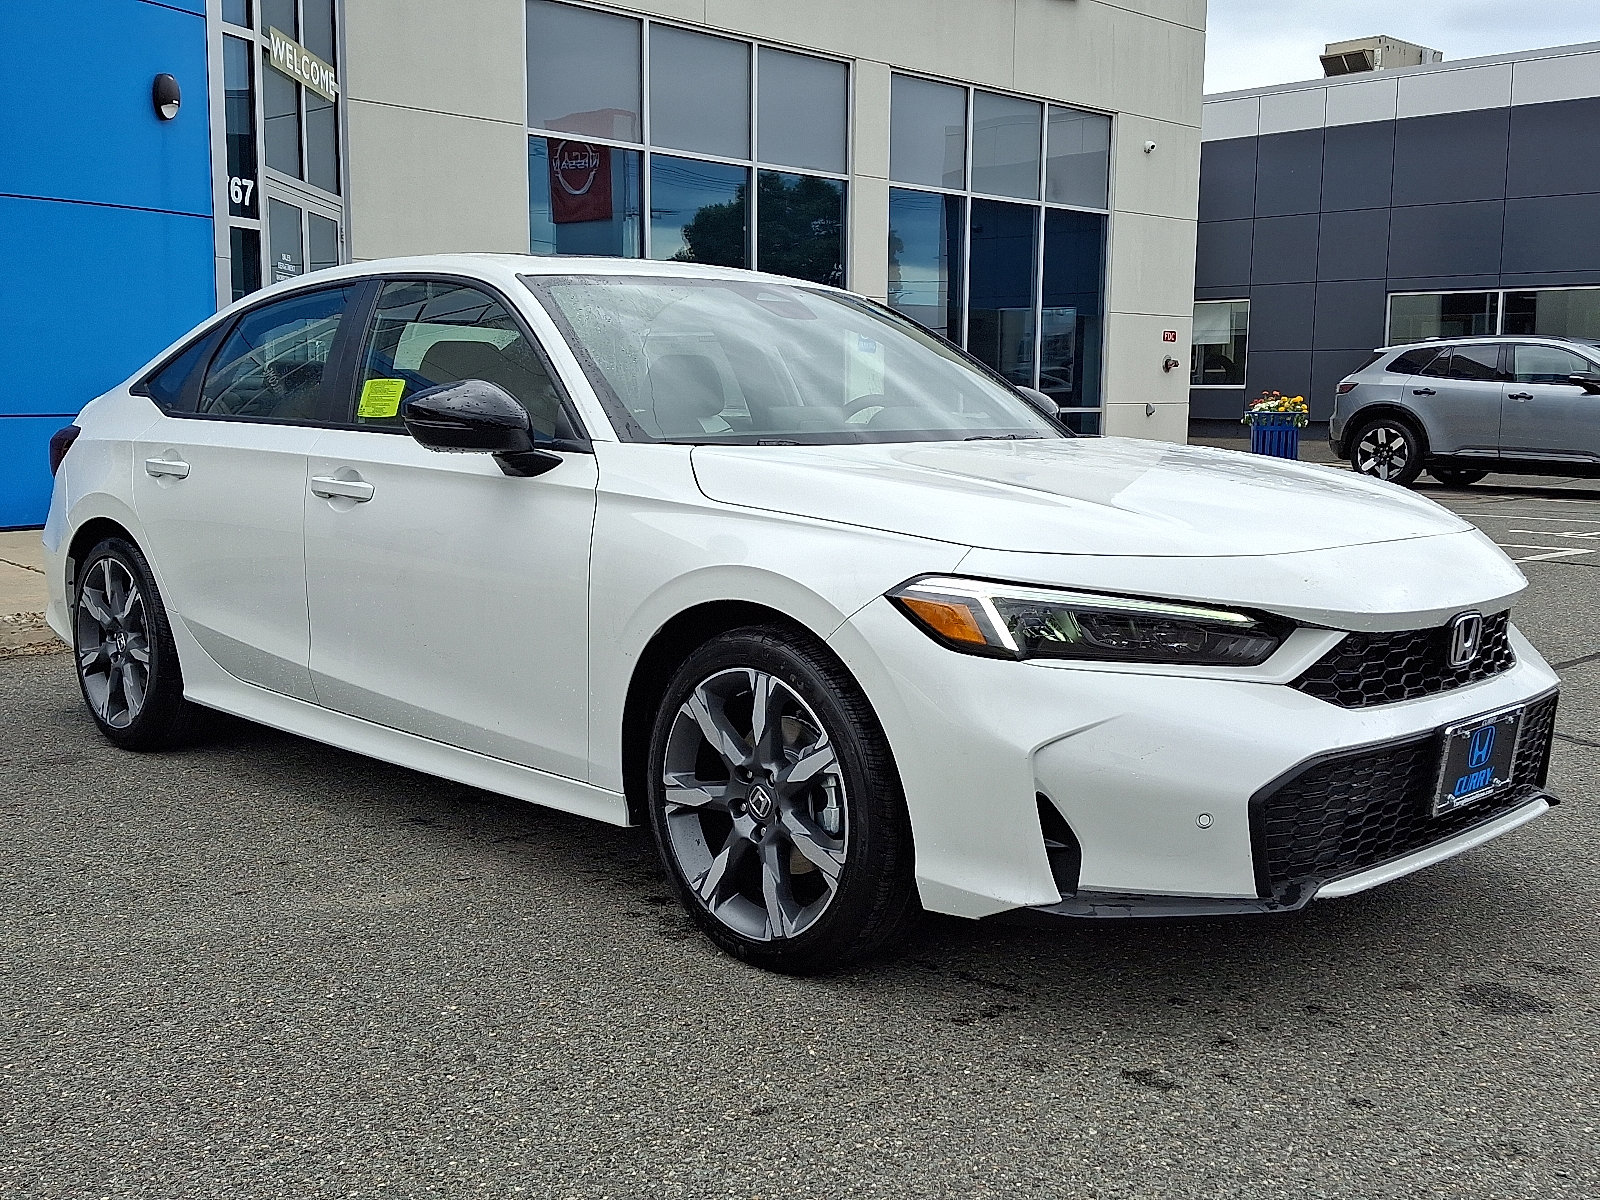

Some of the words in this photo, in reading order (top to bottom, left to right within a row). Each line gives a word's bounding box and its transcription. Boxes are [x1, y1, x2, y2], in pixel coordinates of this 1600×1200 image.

[270, 32, 335, 97] WELCOME
[227, 176, 254, 206] 67
[1164, 332, 1176, 341] FDC
[1454, 766, 1495, 797] CURRY
